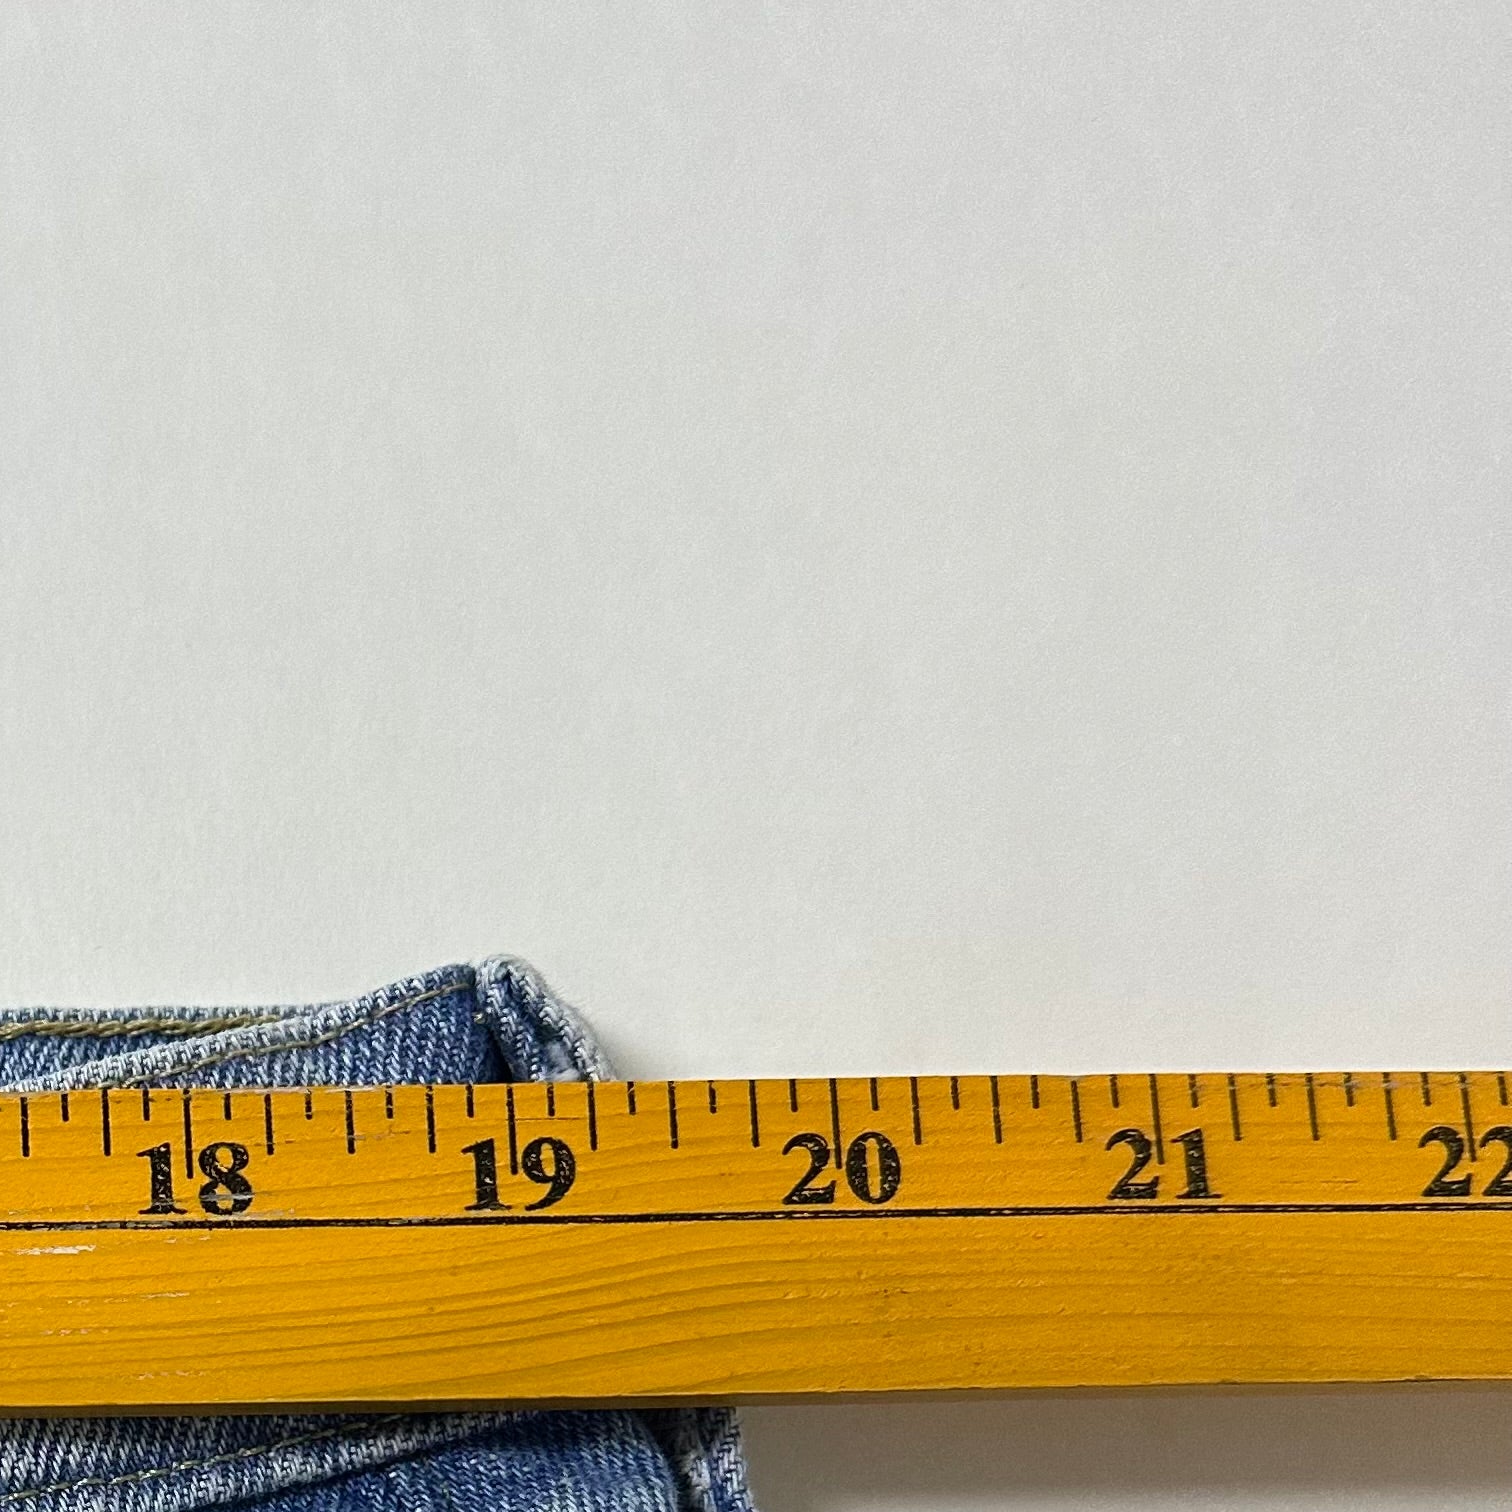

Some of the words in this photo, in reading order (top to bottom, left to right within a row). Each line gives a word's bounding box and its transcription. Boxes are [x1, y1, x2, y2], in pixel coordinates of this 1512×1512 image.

[135, 1140, 254, 1217] 18
[459, 1136, 578, 1212] 19
[780, 1130, 903, 1206] 20
[1104, 1127, 1224, 1201] 21
[1417, 1125, 1512, 1198] 22
